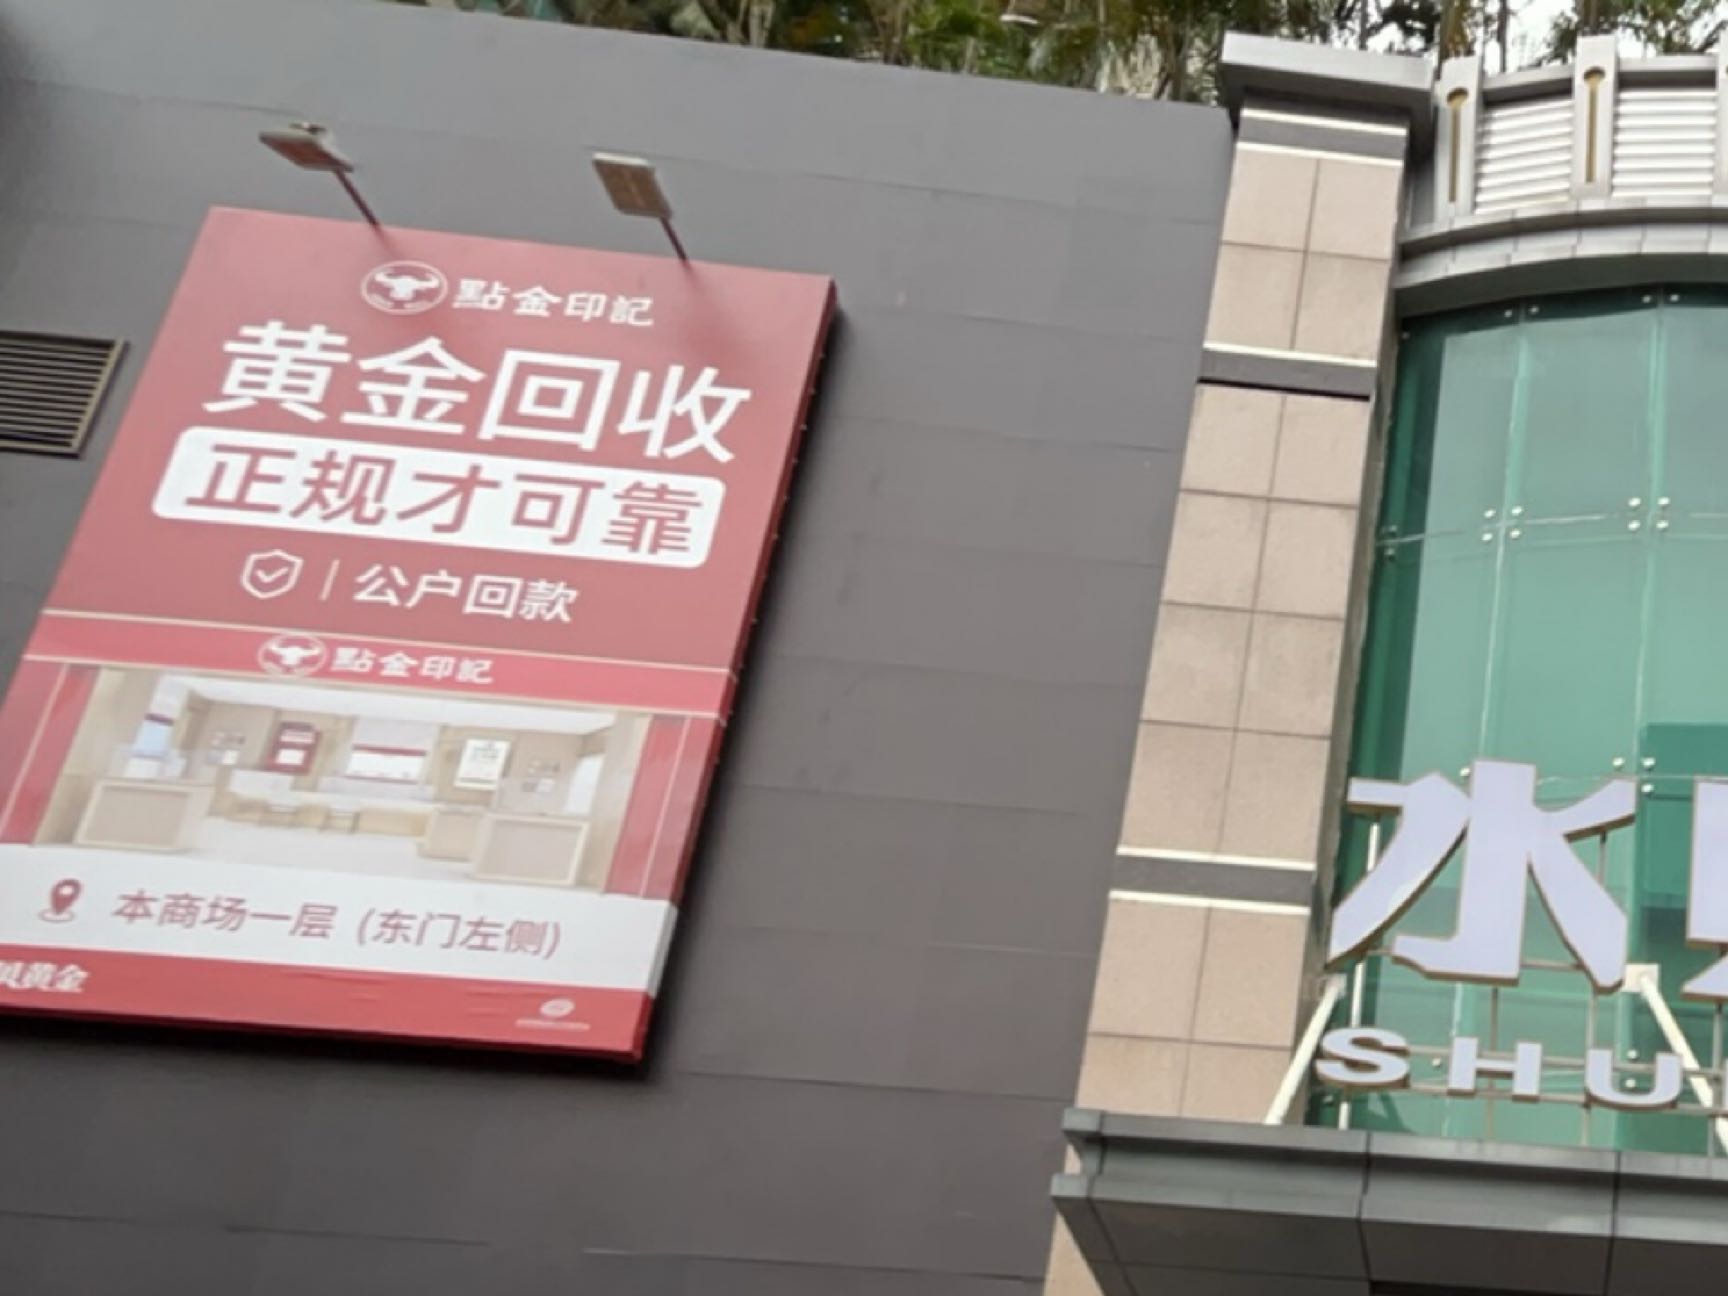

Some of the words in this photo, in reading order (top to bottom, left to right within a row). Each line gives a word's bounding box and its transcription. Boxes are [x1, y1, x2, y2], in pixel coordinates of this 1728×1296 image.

[453, 278, 655, 327] 點金印記
[205, 320, 751, 462] 黄金回收
[184, 443, 704, 556] 正规才可靠
[354, 565, 577, 622] 公户回款
[331, 645, 494, 685] 點金印記
